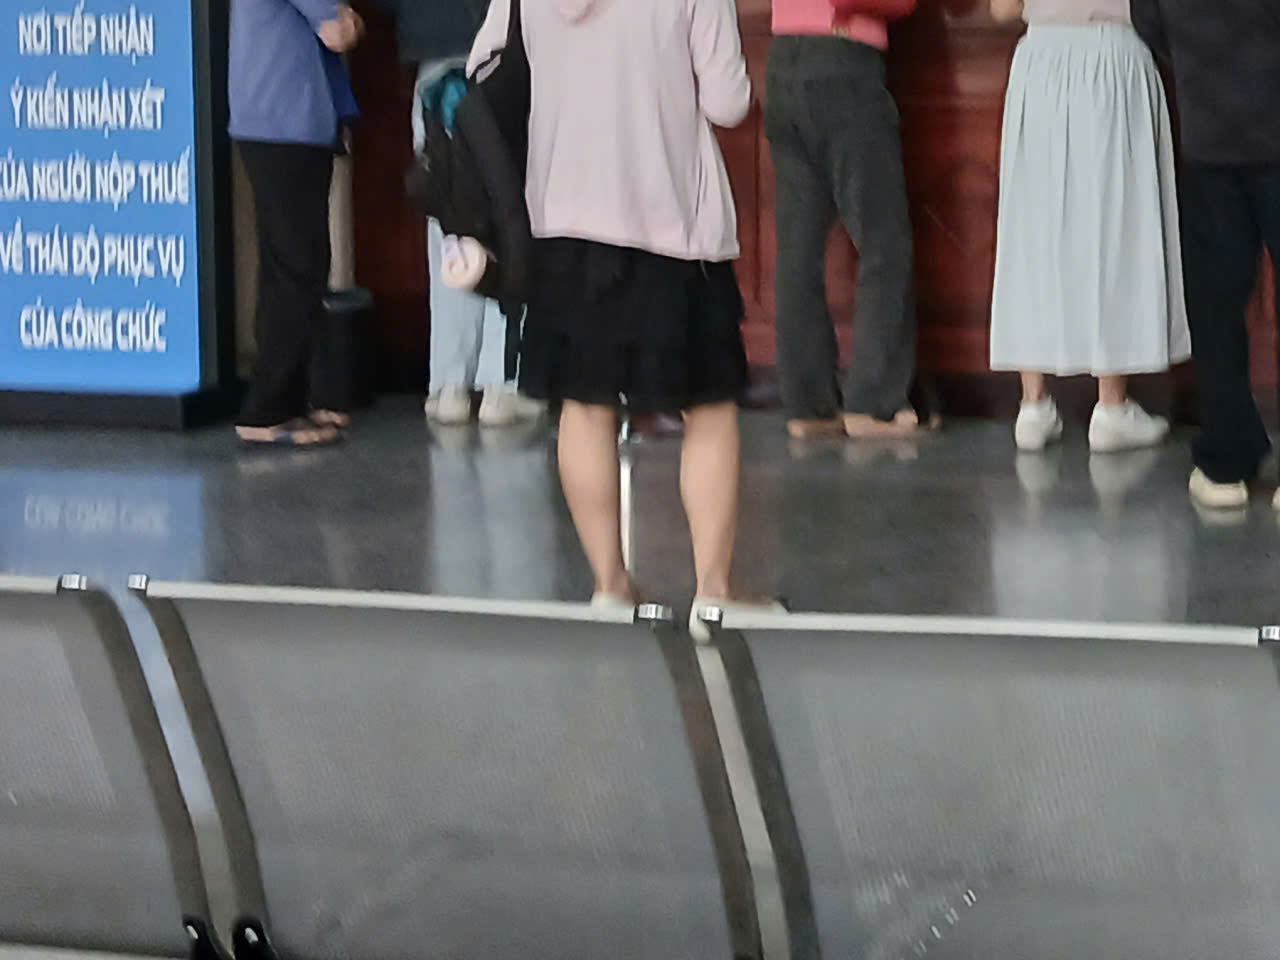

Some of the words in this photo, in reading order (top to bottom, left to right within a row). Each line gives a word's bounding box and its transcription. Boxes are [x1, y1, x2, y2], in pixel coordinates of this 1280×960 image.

[18, 5, 52, 57] NƠI
[100, 3, 154, 66] NHẬN
[10, 74, 24, 129] Ý
[26, 70, 70, 130] KIẾN
[73, 77, 126, 139] NHẬN
[128, 77, 166, 130] XÉT
[33, 149, 92, 203] NGƯỜI
[95, 150, 136, 213] NỘP
[138, 144, 191, 205] THUẾ
[26, 223, 68, 277] THÁI
[103, 231, 155, 287] PHỤC
[157, 232, 185, 289] VỤ
[61, 297, 113, 352] CÔNG
[116, 299, 167, 353] CHỨC
